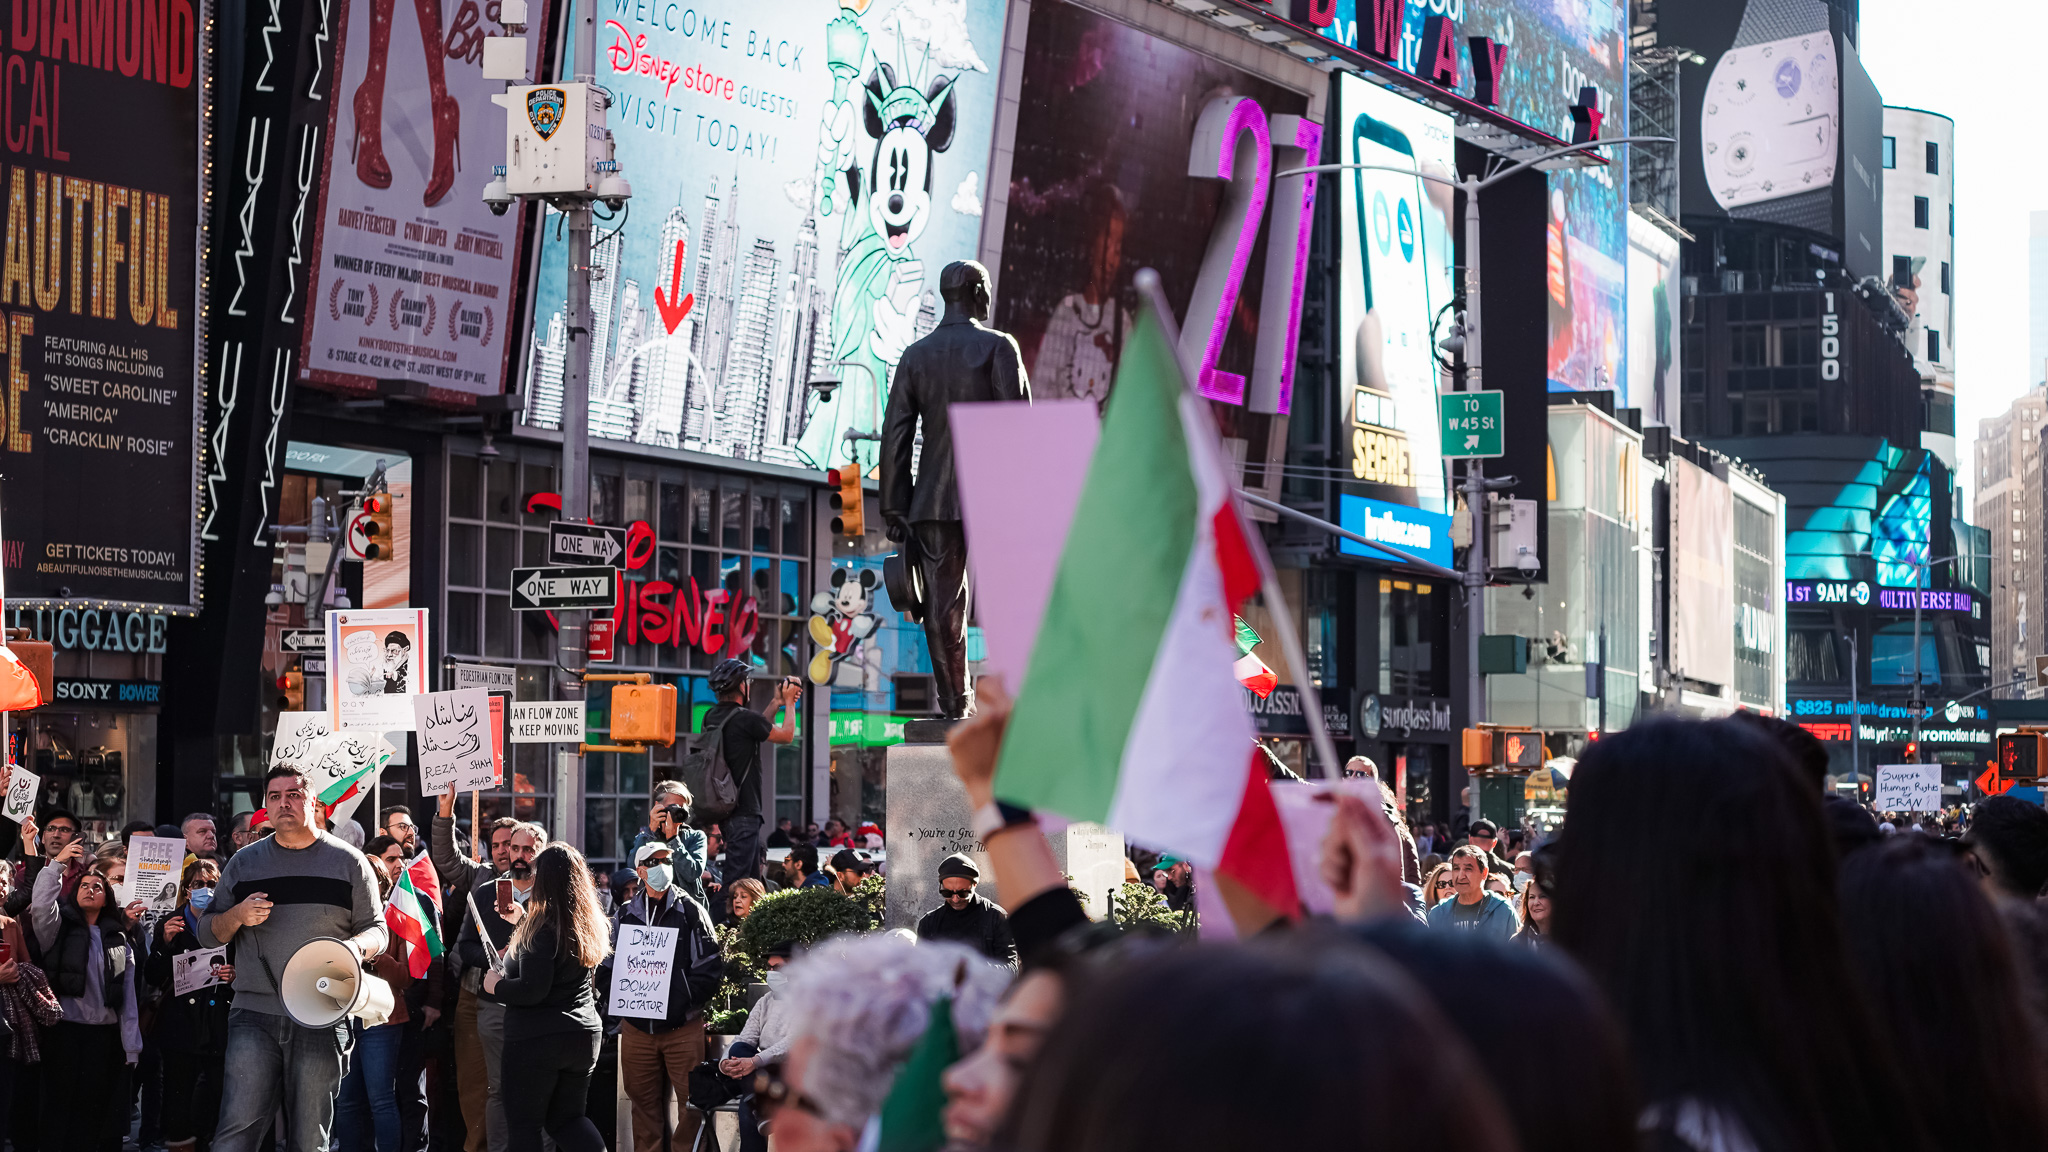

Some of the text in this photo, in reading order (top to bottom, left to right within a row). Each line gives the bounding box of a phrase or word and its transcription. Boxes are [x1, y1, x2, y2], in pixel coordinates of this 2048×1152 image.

[614, 0, 804, 72] WELCOME BACK
[12, 0, 194, 89] DIAMOND
[536, 89, 557, 97] POLICE
[684, 63, 734, 101] store
[739, 85, 798, 120] GUESTS!
[528, 94, 564, 106] DEPARTMENT
[620, 92, 777, 163] VISIT TODAY!
[596, 160, 617, 172] NYPD
[338, 208, 364, 230] HARVEY
[364, 213, 397, 237] FIERSTEIN
[404, 221, 424, 243] CYNDI
[424, 226, 448, 248] LAUPER
[0, 164, 178, 330] AUTIFUL
[454, 233, 474, 253] JERRY
[473, 236, 503, 260] MITCHELL
[334, 253, 363, 273] WINNER
[364, 260, 374, 274] OF
[374, 261, 396, 279] EVERY
[397, 265, 423, 285] MAJOR
[423, 271, 441, 288] BEST
[441, 275, 471, 294] MUSICAL
[473, 281, 499, 299] AWARD!
[348, 288, 364, 303] TONY
[343, 302, 365, 318] AWARD
[401, 298, 427, 314] GRAMMY
[401, 312, 423, 328] AWARD
[460, 309, 483, 325] OLIVIER
[460, 323, 480, 339] AWARD
[1821, 292, 1840, 381] 1500
[45, 335, 149, 361] FEATURING ALL HIS
[358, 336, 457, 362] KINKYBOOTSTHEMUSICAL.COM
[45, 352, 164, 378] HIT SONGS INCLUDING
[336, 349, 357, 363] STAGE
[370, 355, 382, 367] 422
[383, 357, 391, 369] W.
[407, 361, 416, 373] ST.
[417, 363, 435, 376] JUST
[436, 365, 453, 379] WEST
[454, 368, 463, 380] OF
[473, 371, 487, 385] AVE.
[1463, 399, 1480, 412] TO
[1449, 416, 1494, 430] W 45 St
[561, 536, 615, 556] ONE WAY
[46, 543, 175, 567] GET TICKETS TODAY!
[36, 563, 183, 582] ABEAUTIFULNOISETHEMUSICAL.COM
[527, 579, 602, 597] ONE WAY
[1816, 582, 1848, 602] 9AM
[290, 636, 306, 645] ONE
[307, 661, 319, 670] ONE
[460, 669, 513, 685] PEDESTRIAN FLOW ZONE
[56, 682, 160, 701] SONY BOWER
[1266, 691, 1302, 715] ASSN.
[1795, 699, 1832, 716] $825
[528, 707, 552, 719] FLOW
[555, 707, 579, 719] ZONE
[1324, 713, 1348, 722] POLO
[1382, 701, 1451, 738] sunglass hut
[1960, 705, 1974, 719] NEWS
[519, 723, 579, 736] KEEP MOVING
[425, 758, 493, 779] REZA SHAH
[1882, 768, 1921, 783] Support
[467, 776, 492, 786] SHAD
[1880, 782, 1938, 793] Human Rights
[1886, 797, 1923, 808] IRAN
[918, 827, 975, 841] You're a Gra
[140, 841, 174, 859] FREE
[949, 840, 988, 852] Over Th
[619, 978, 661, 992] DOWN
[617, 998, 663, 1013] DICTATOR
